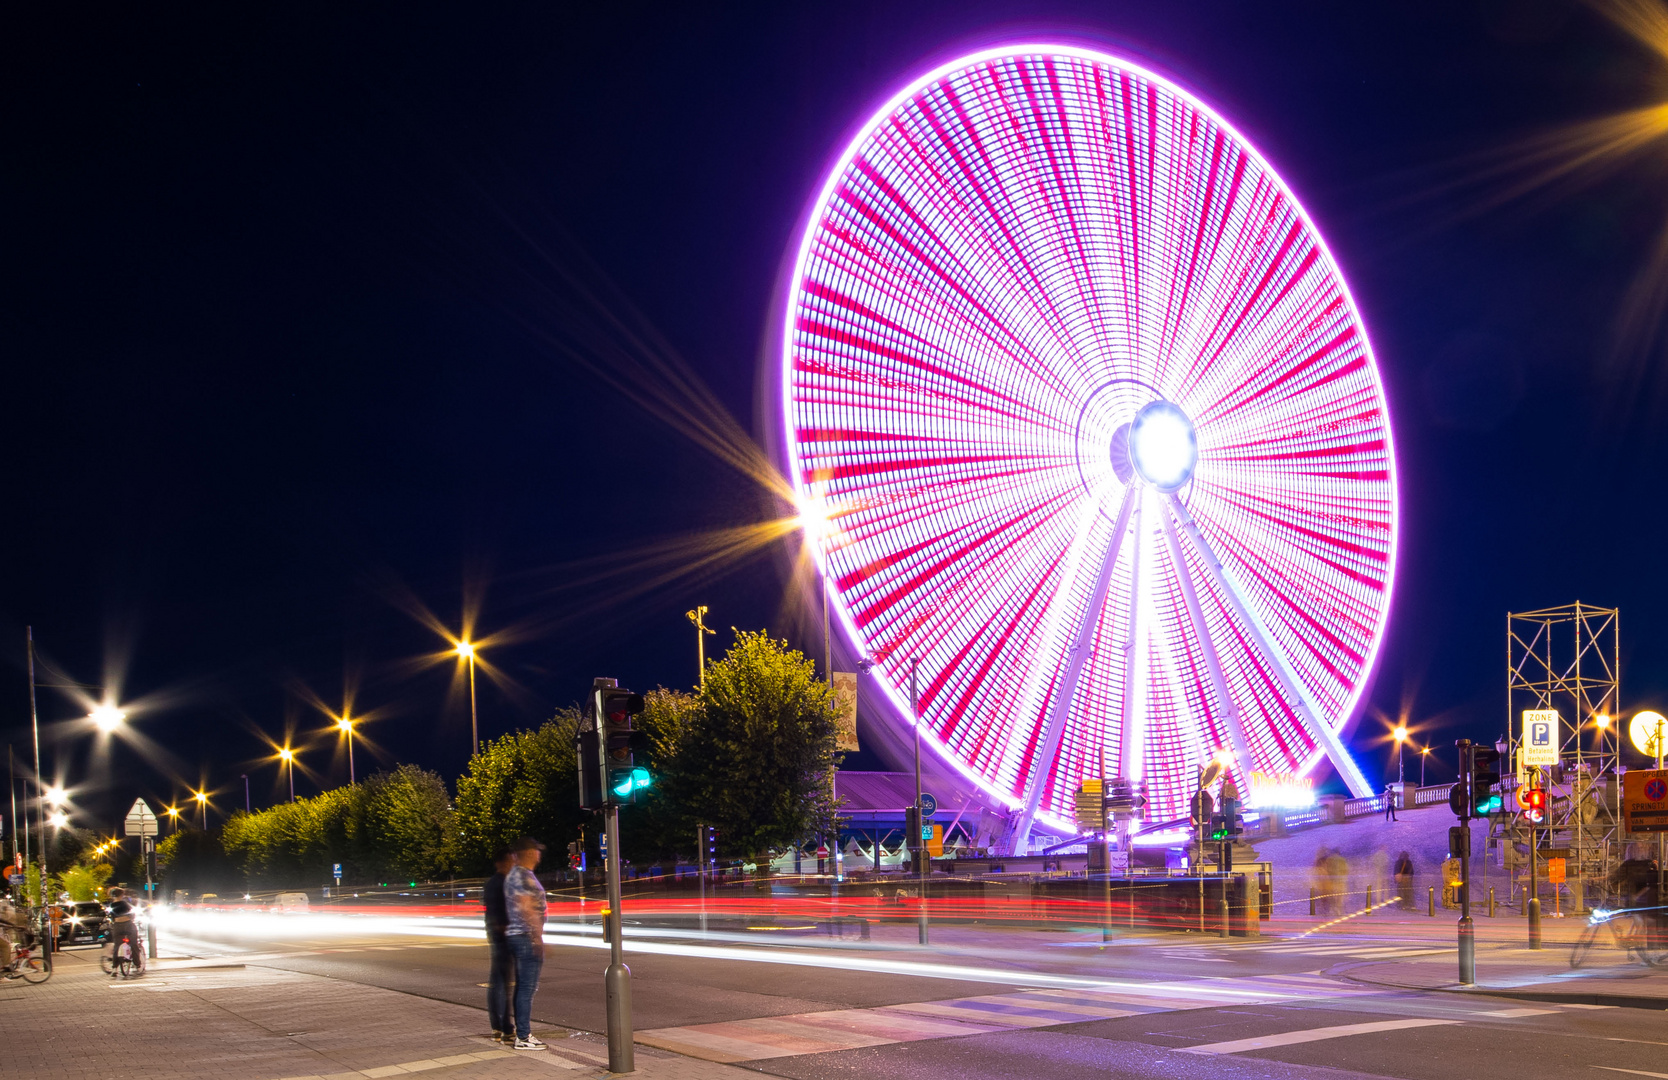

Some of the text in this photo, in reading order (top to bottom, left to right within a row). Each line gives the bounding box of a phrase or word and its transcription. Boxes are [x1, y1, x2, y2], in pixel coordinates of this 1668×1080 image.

[1535, 724, 1547, 740] P
[1251, 771, 1313, 789] The View
